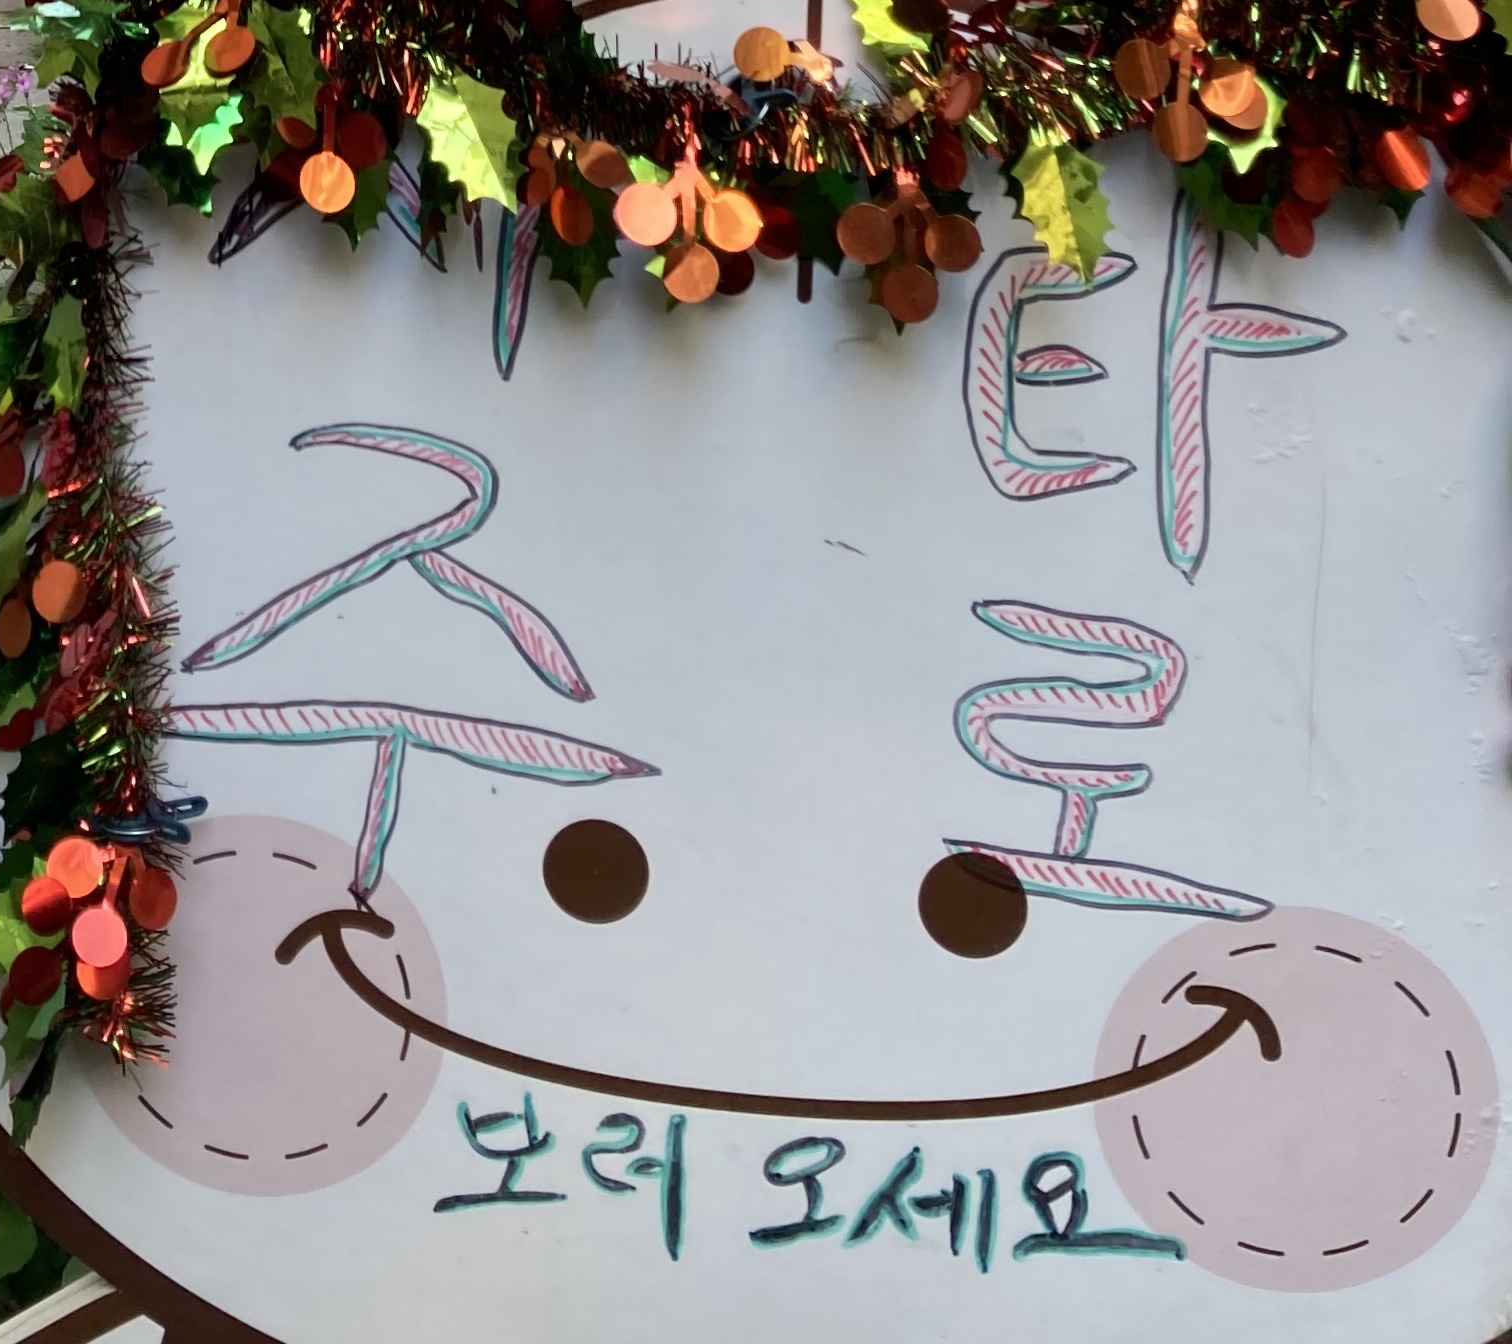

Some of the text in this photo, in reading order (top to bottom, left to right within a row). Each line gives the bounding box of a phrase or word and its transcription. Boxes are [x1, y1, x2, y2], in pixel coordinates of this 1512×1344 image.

[941, 188, 1348, 922] 타로
[432, 1090, 1188, 1275] 보러 오세요
